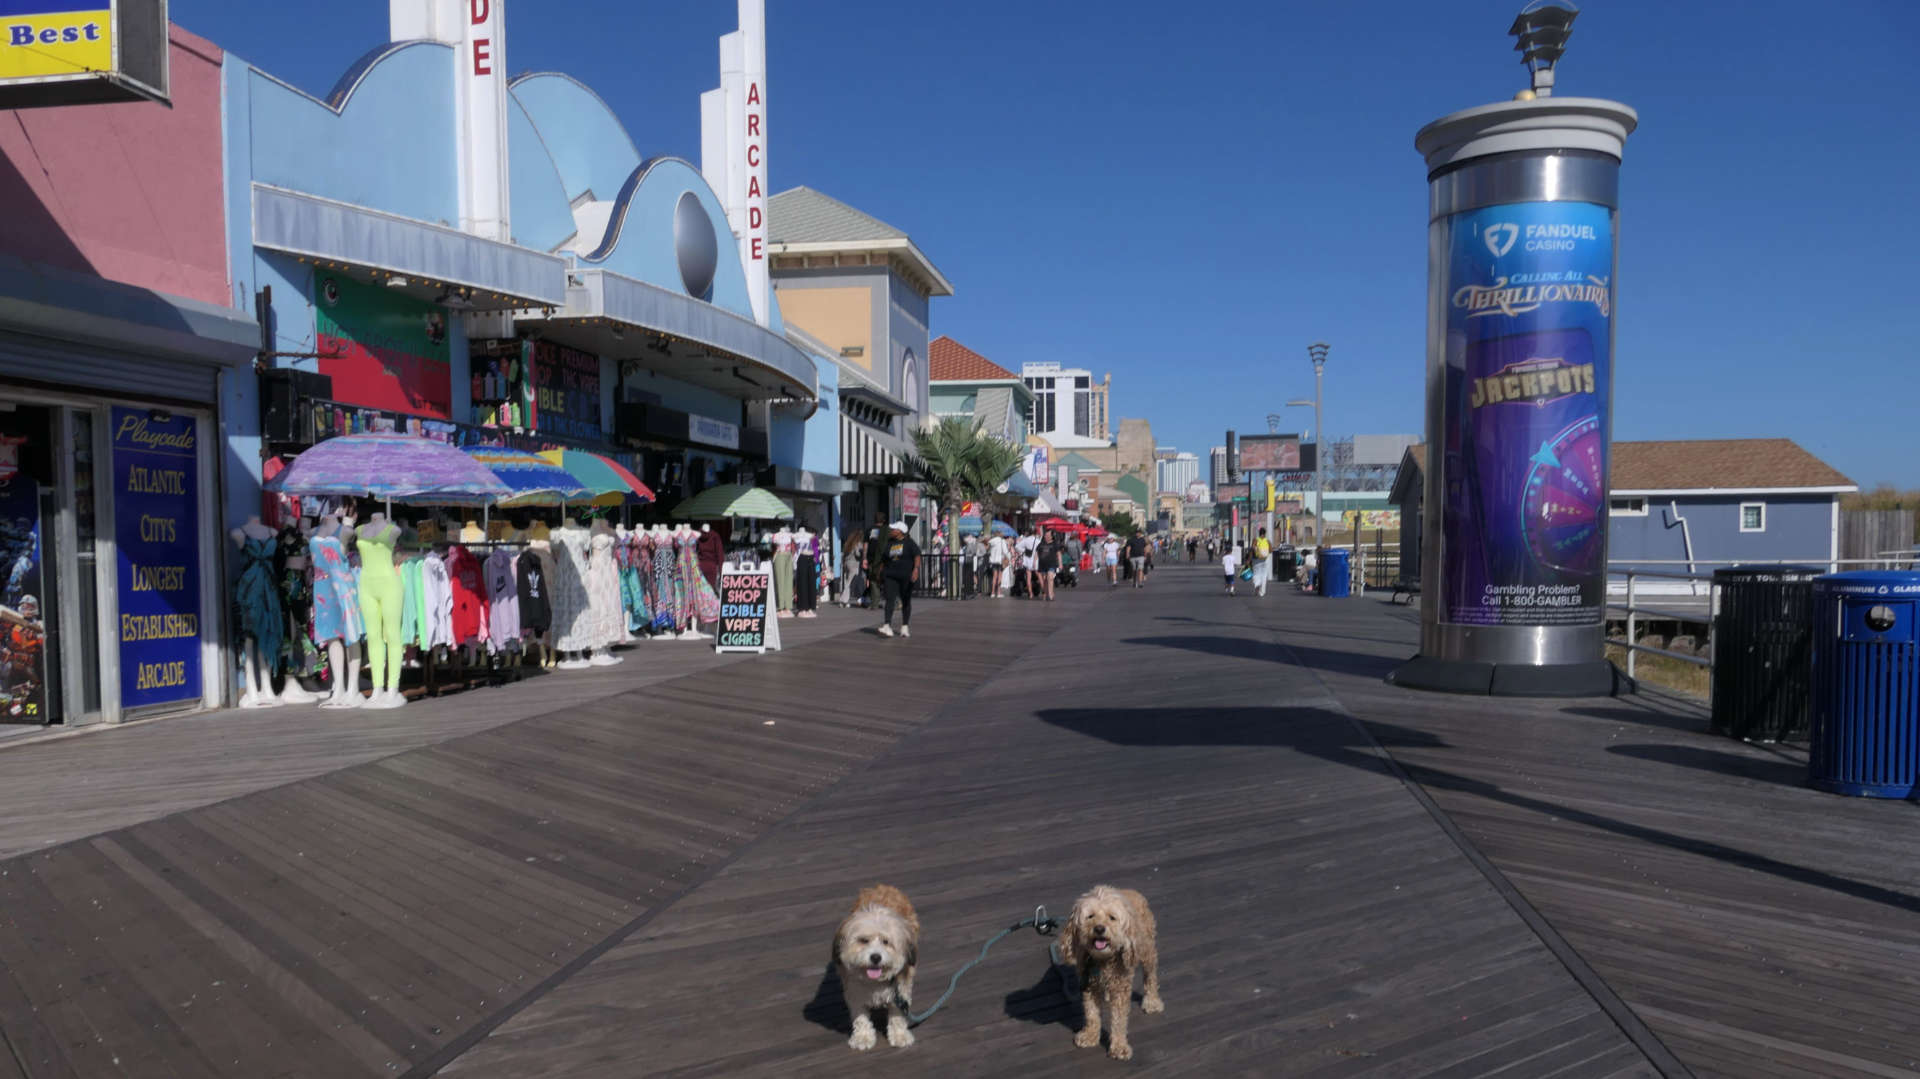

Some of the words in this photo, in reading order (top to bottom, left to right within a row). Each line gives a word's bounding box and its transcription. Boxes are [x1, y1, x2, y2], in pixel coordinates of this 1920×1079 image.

[9, 22, 100, 46] Best
[747, 82, 763, 260] ARCADE
[1525, 223, 1596, 240] FANDUEL
[1525, 240, 1575, 252] CASINO
[1511, 272, 1561, 284] CALLING
[1563, 270, 1583, 281] ALL
[1471, 362, 1595, 408] JACKPOTS
[115, 415, 195, 449] Playcade
[128, 463, 186, 495] ATLANTIC
[131, 563, 186, 592] LONGEST
[722, 575, 768, 589] SMOKE
[1756, 574, 1799, 582] TOUISM
[727, 589, 761, 603] SHOP
[1485, 584, 1535, 597] Gambling
[1537, 584, 1581, 595] Problem?
[1481, 595, 1502, 606] Call
[1504, 595, 1581, 606] 1-800-GAMBLER
[721, 604, 764, 617] EDIBLE
[121, 613, 197, 642] ESTABLISHED
[724, 618, 760, 632] VAPE
[720, 633, 761, 645] CIGARS
[136, 661, 186, 690] ARCADE
